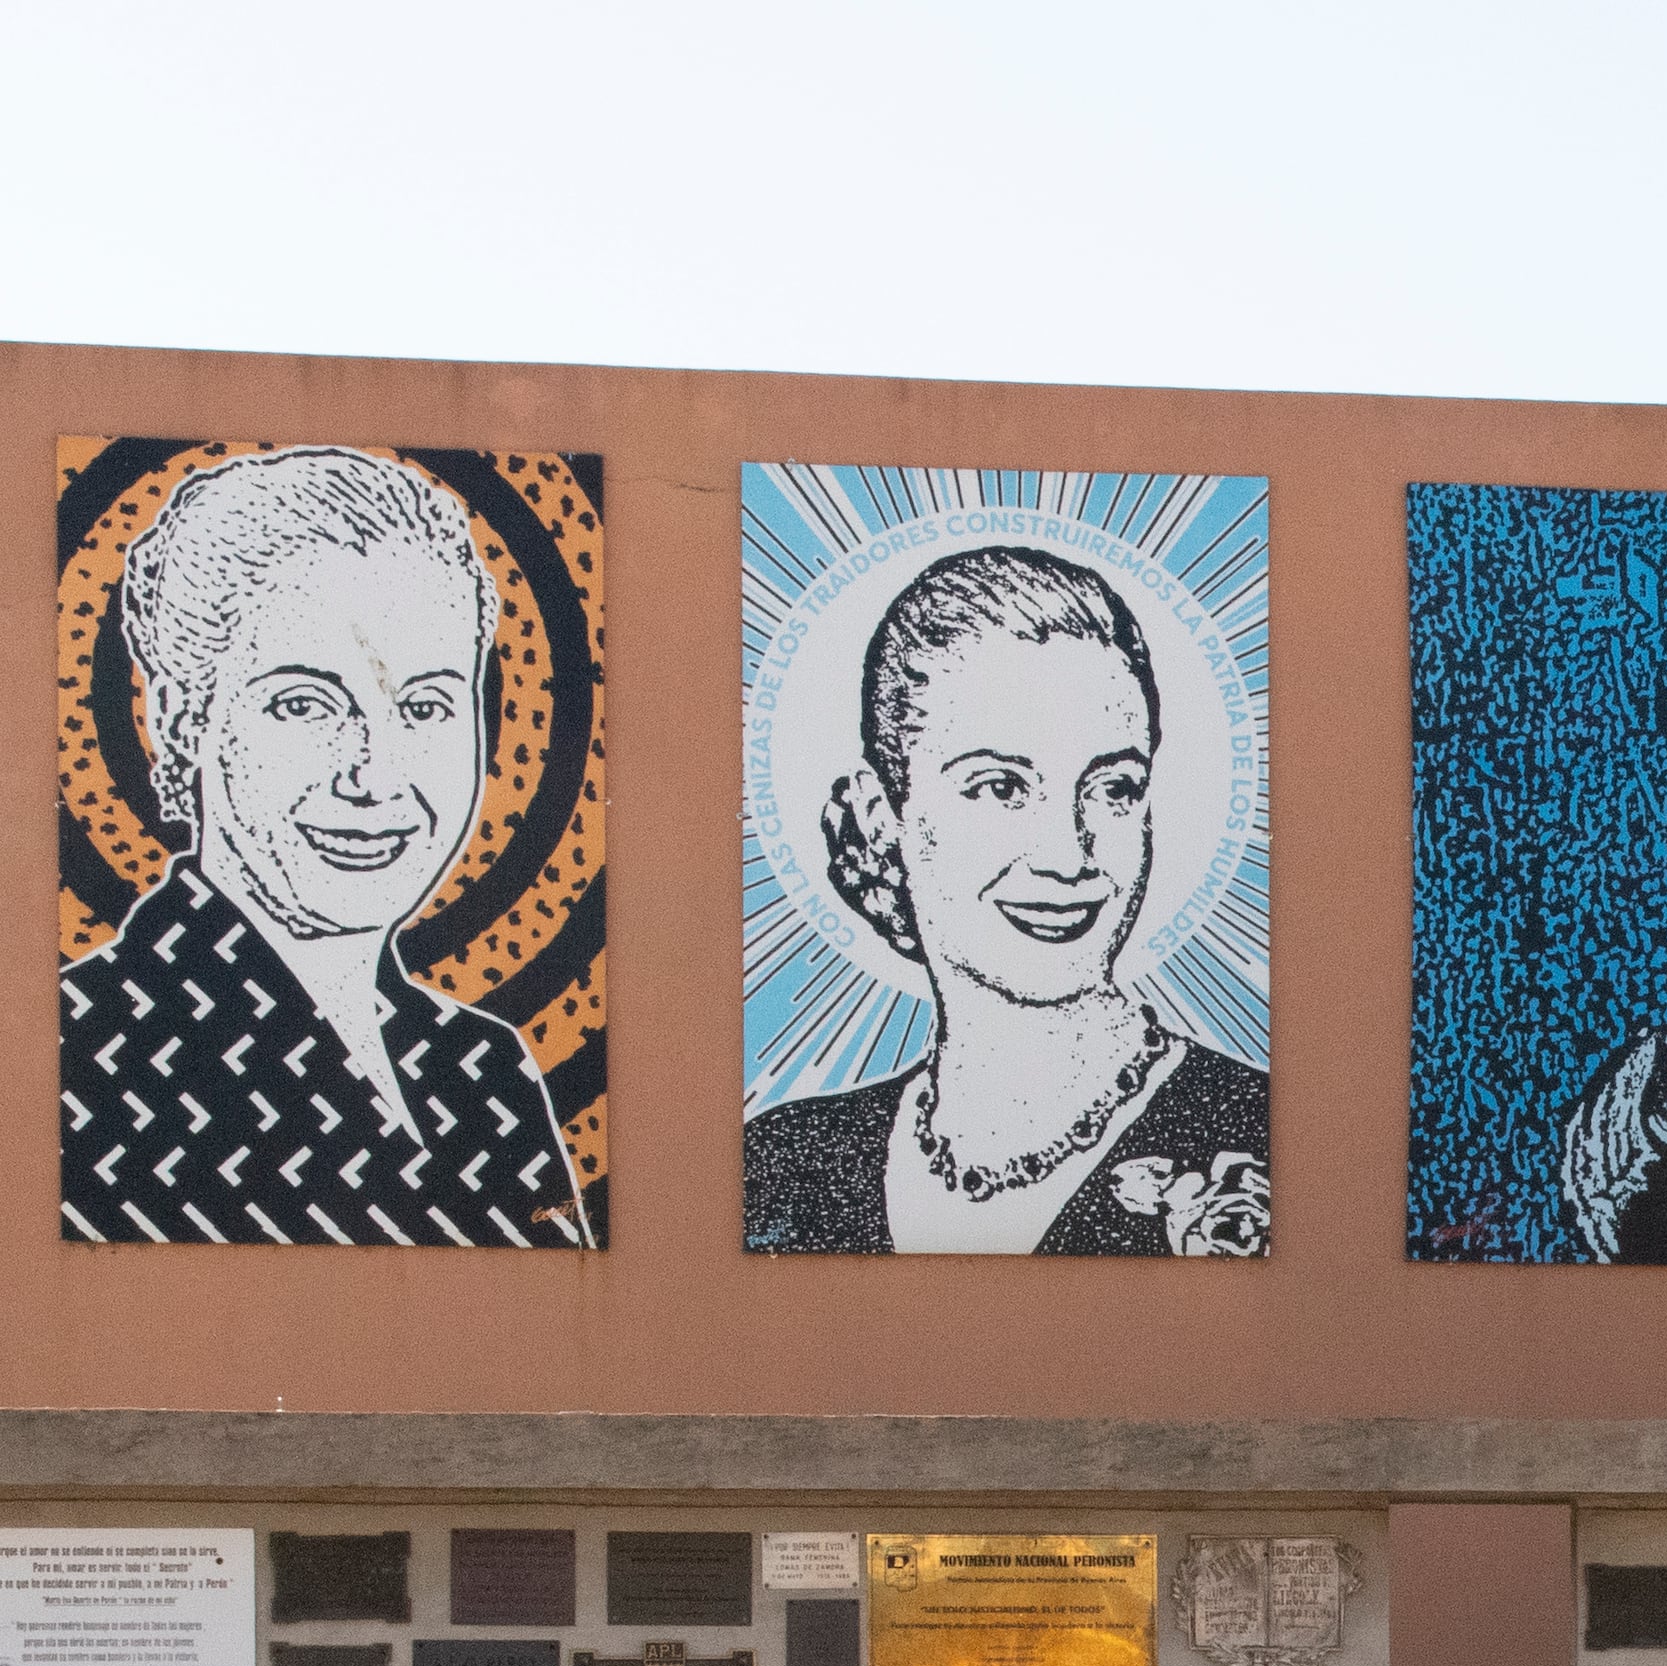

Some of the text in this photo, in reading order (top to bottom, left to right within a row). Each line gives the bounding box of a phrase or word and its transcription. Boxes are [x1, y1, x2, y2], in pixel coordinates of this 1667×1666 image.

[800, 518, 941, 618] TRAIDORES
[946, 508, 1181, 602] CONSTRUIREMOS
[1172, 596, 1203, 637] LA
[767, 619, 810, 672] LOS
[757, 673, 783, 711] DE
[1197, 635, 1249, 731] PATRIA
[749, 718, 784, 841] CENIZAS
[1229, 734, 1252, 773] DE
[1225, 780, 1251, 833] LOS
[771, 842, 813, 898] LAS
[804, 897, 855, 949] CON
[940, 1554, 1137, 1567] MOVIMIENTO NACIONAL PERONISTA
[648, 1644, 682, 1658] APL
